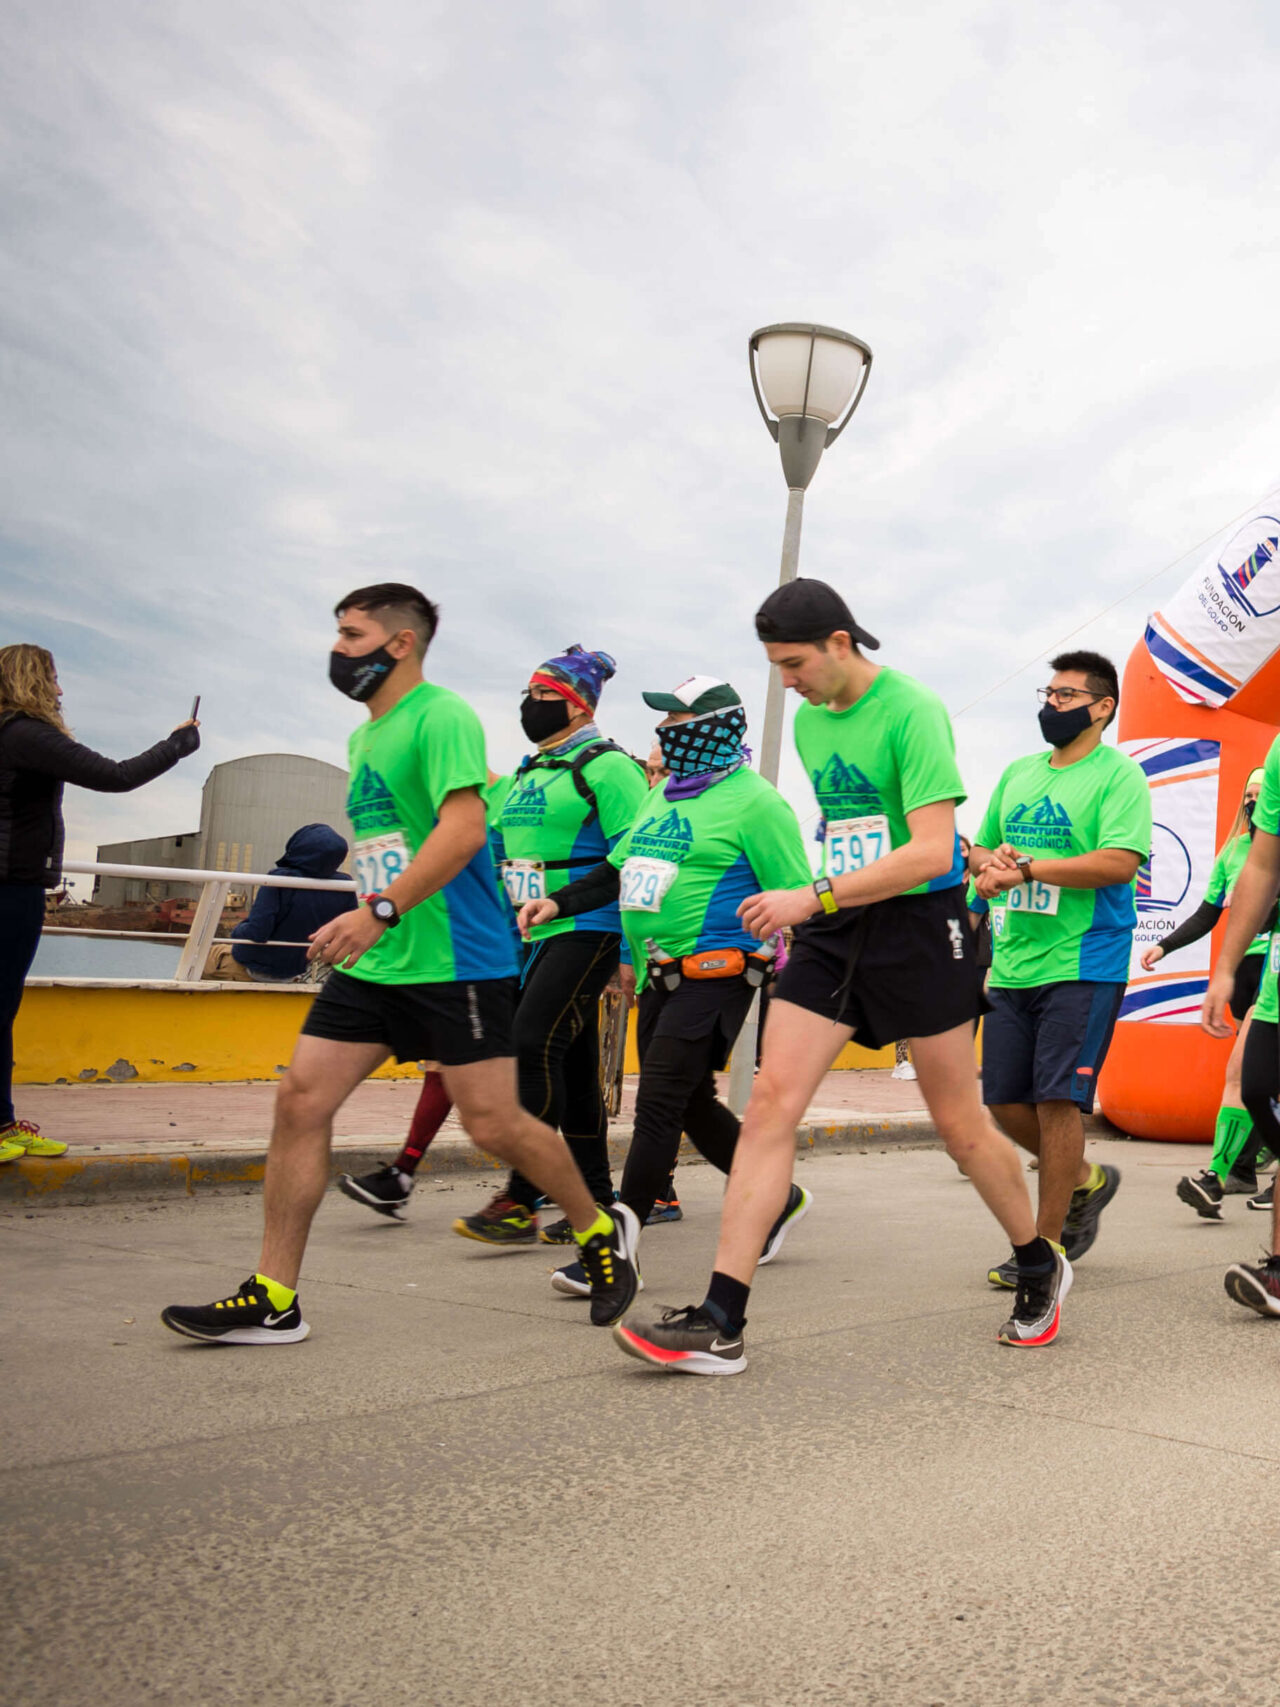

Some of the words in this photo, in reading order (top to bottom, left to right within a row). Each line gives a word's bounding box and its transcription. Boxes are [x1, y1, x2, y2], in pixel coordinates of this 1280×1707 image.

[1198, 592, 1208, 608] DEL
[1207, 606, 1229, 632] GOLFO
[1203, 576, 1246, 632] FUNDACIÓN
[1006, 825, 1072, 836] AVENTURA
[1006, 836, 1072, 849] PATAGONICA
[831, 832, 882, 876] 597
[505, 871, 540, 901] 576
[1137, 917, 1176, 930] ACIÓN
[1134, 934, 1164, 942] GOLFO
